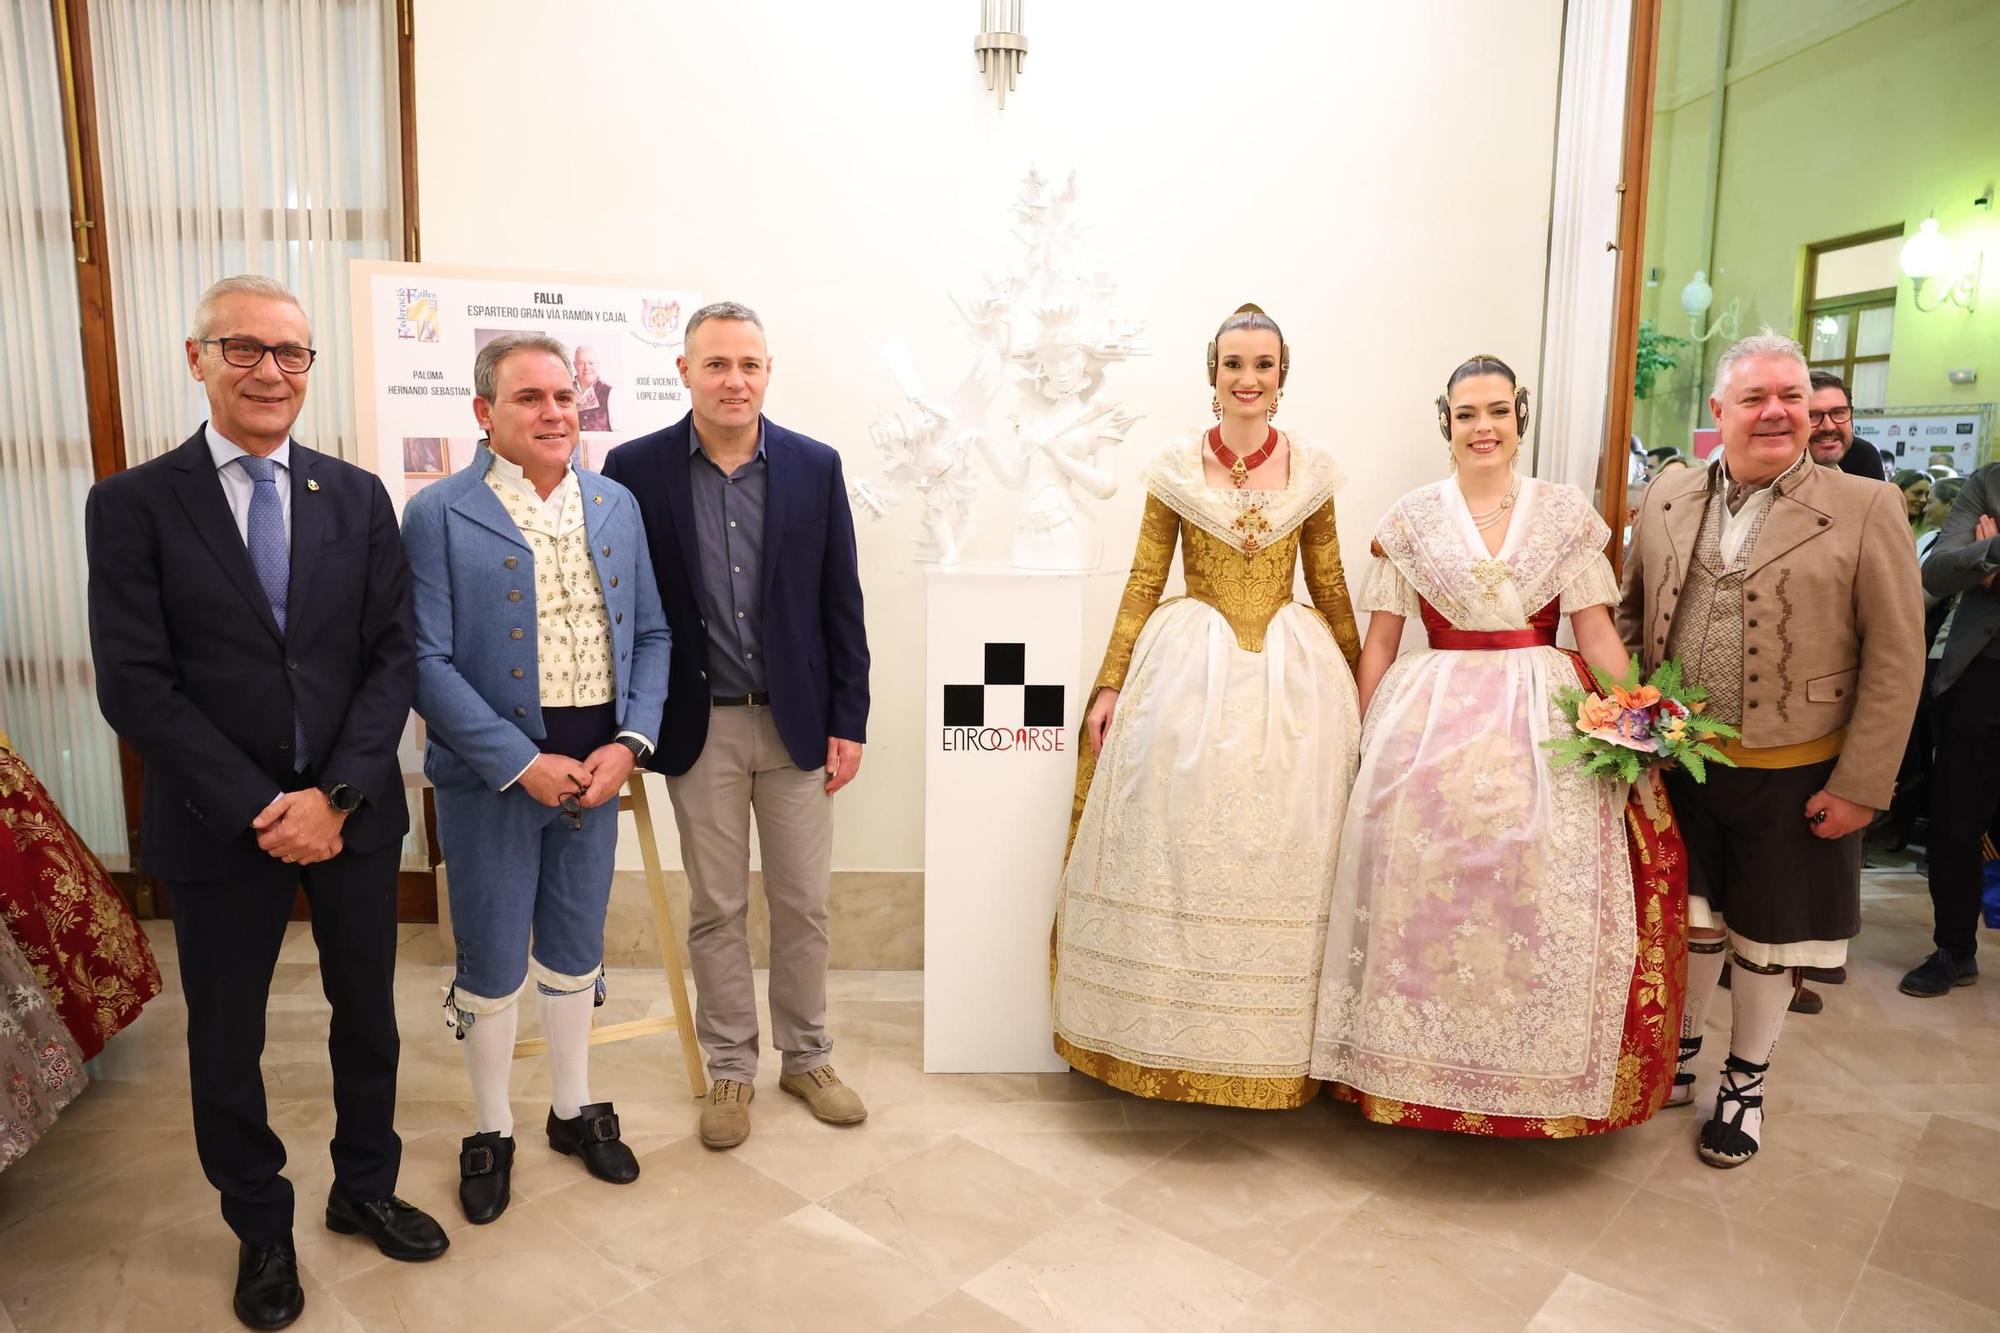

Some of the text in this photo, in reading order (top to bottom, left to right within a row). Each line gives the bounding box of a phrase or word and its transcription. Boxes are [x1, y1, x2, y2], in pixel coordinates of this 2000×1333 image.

[534, 292, 564, 305] FALLA
[467, 305, 519, 318] ESPARTERO
[520, 308, 544, 319] GRAN
[595, 311, 601, 321] Y
[602, 311, 629, 323] CAJAL
[413, 370, 444, 380] PALOMA
[652, 377, 679, 387] VICENTE
[388, 385, 428, 395] HERNANDO
